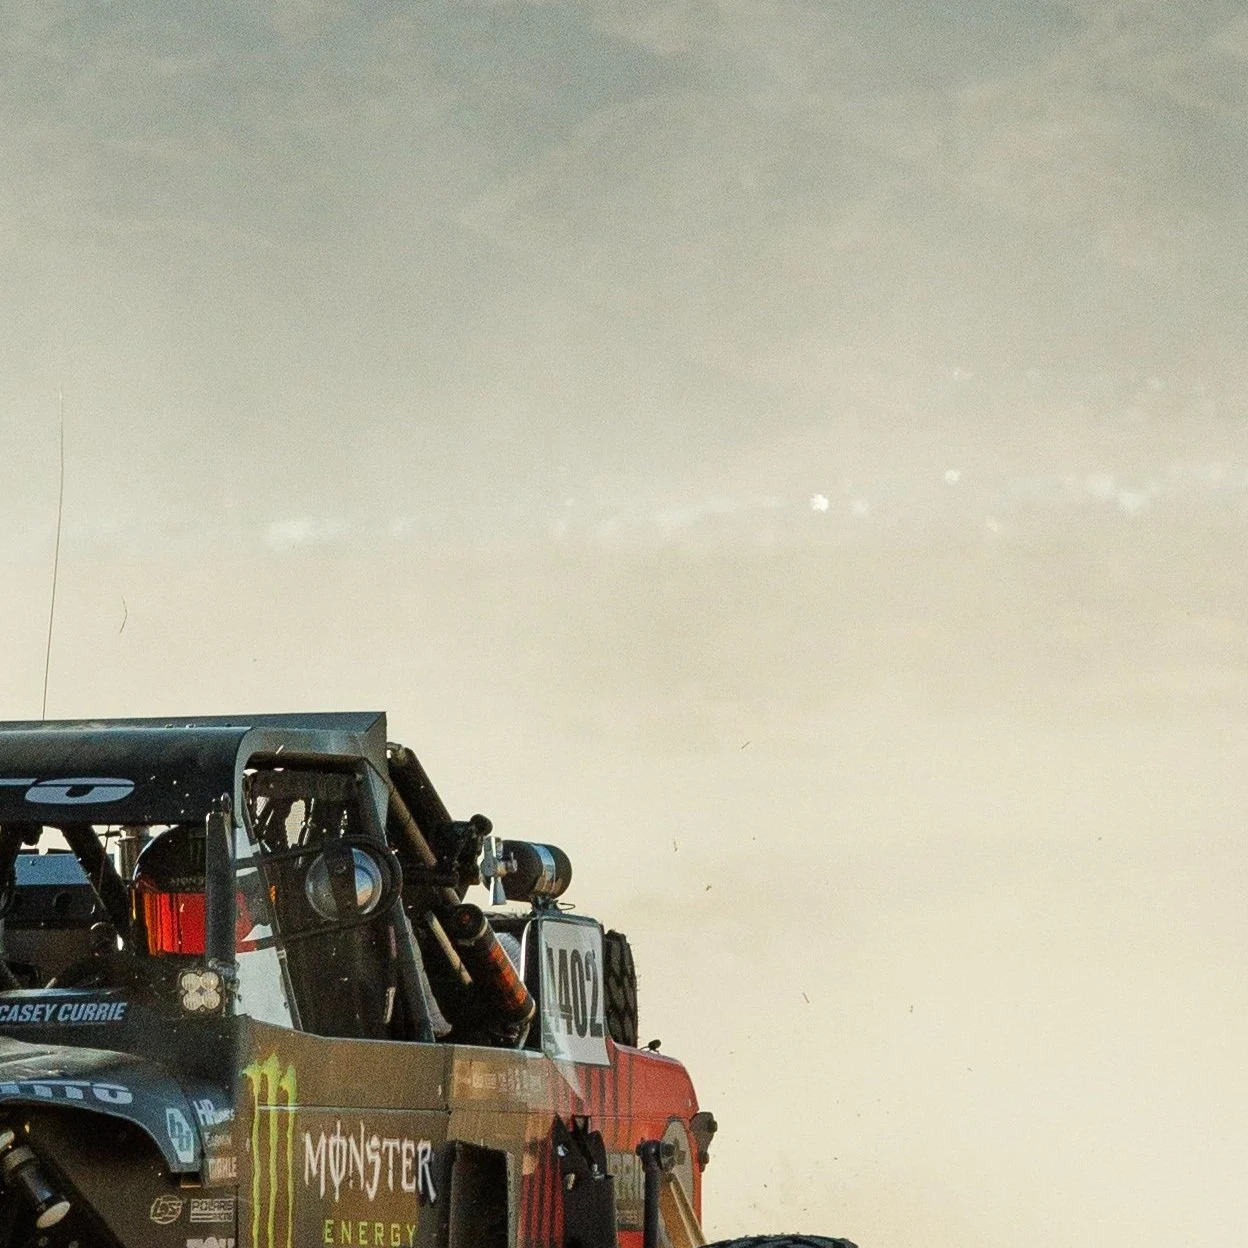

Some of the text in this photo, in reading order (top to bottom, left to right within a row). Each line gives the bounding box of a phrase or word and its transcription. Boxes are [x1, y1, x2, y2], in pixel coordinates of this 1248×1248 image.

[57, 1002, 128, 1022] CURRIE
[303, 1119, 437, 1203] MONSTER
[323, 1219, 417, 1248] ENERGY
